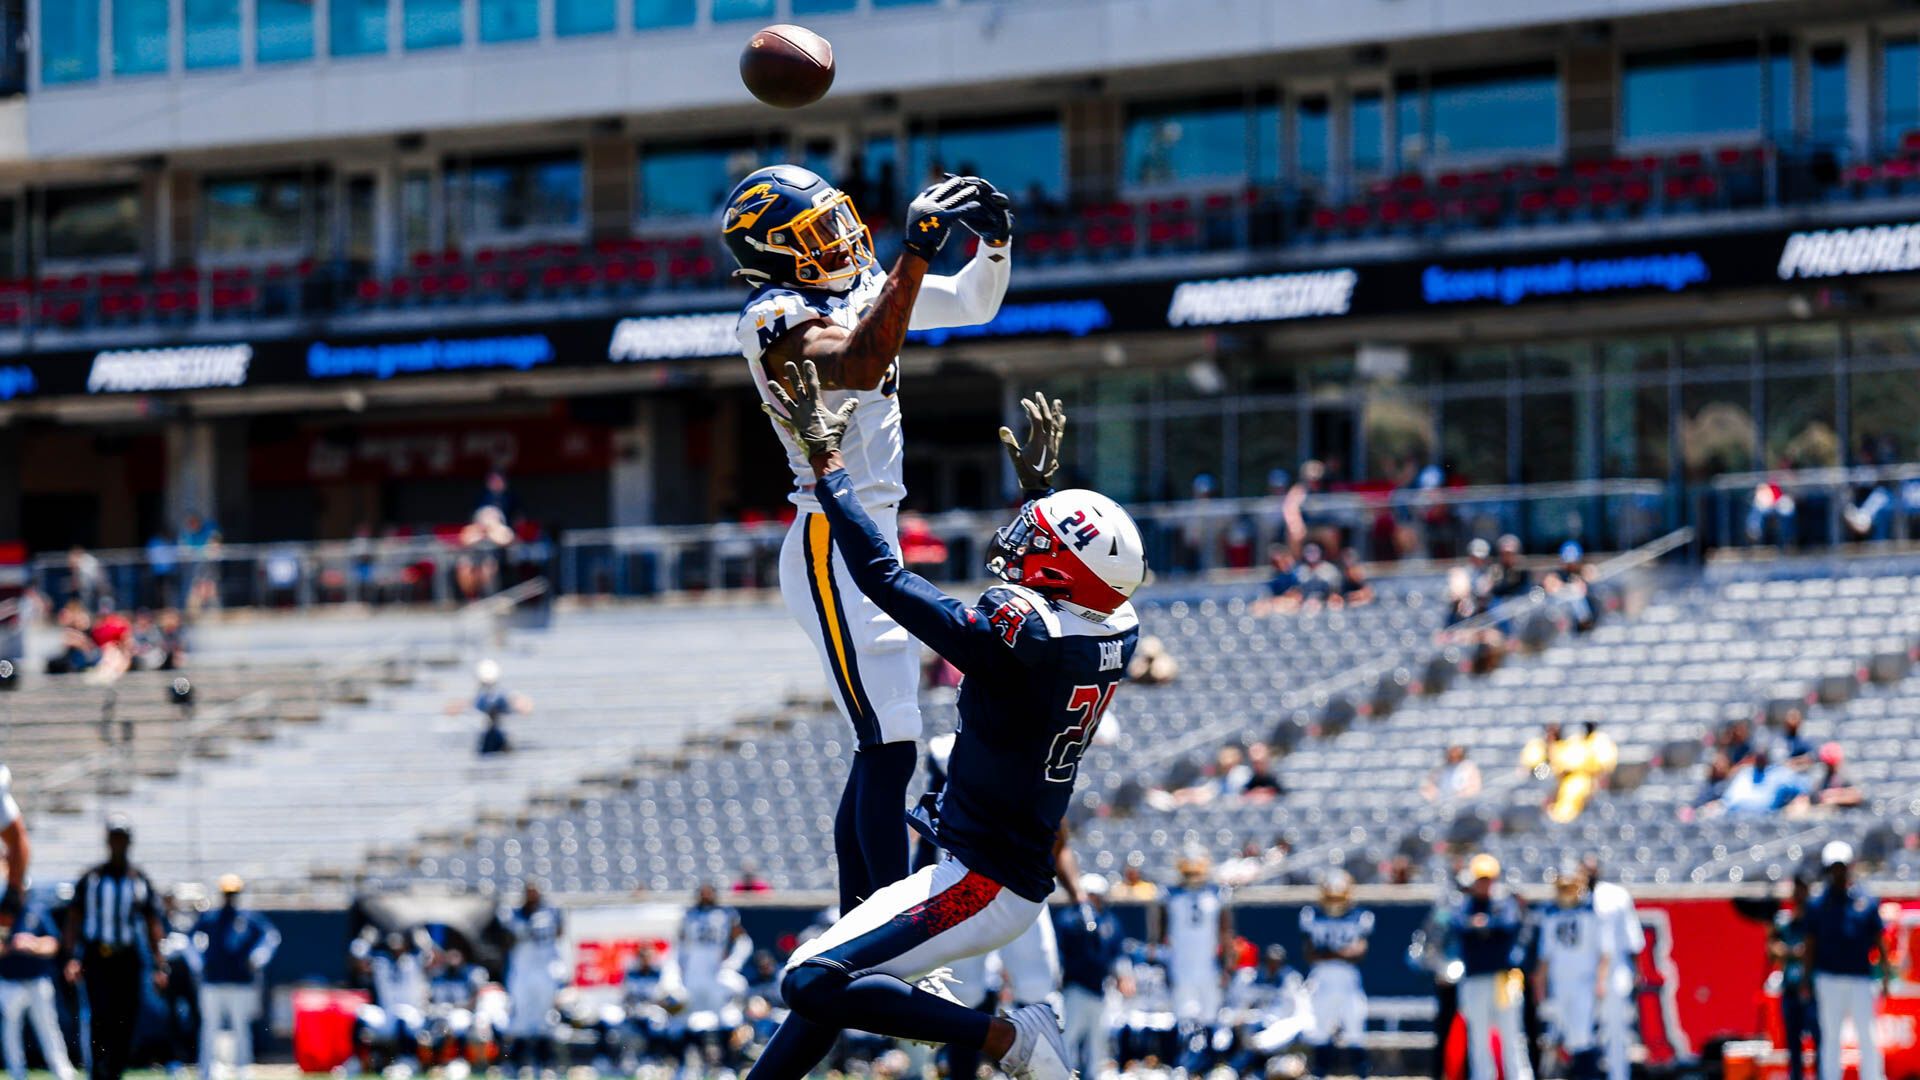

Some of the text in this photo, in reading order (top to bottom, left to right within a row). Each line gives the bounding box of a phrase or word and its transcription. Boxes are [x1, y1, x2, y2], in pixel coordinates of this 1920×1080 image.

[1168, 268, 1358, 327] PROGRESSIVE
[88, 343, 253, 392] PROGRESSIVE
[1057, 510, 1101, 552] 24
